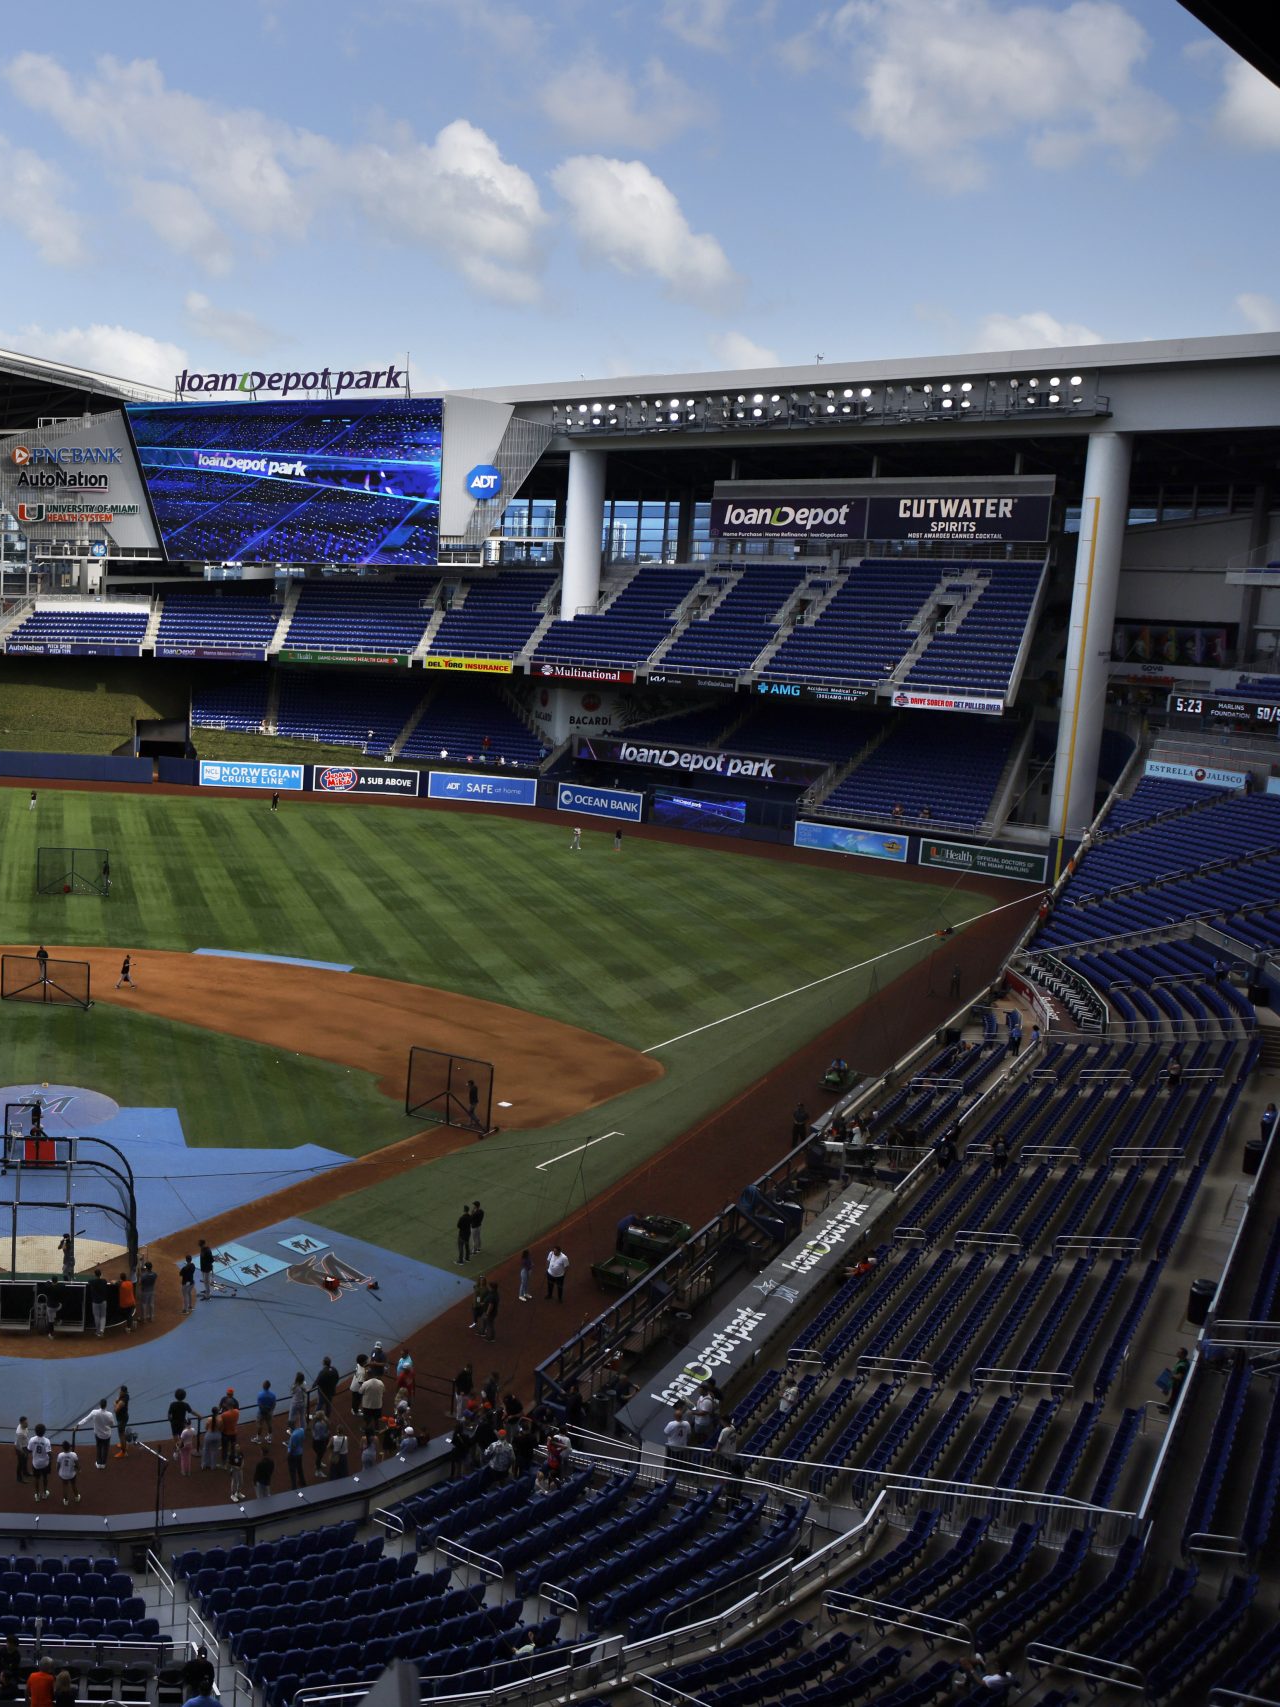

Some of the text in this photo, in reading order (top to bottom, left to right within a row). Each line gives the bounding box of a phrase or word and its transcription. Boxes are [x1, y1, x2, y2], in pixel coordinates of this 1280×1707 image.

[181, 365, 402, 397] loanDepot park
[198, 452, 308, 477] loanDepot park
[18, 471, 108, 487] AutoNation
[471, 475, 498, 488] ADT
[47, 504, 139, 514] UNIVERSITY OF MIAMI
[898, 498, 1013, 518] CUTWATER
[48, 514, 112, 522] HEALTH SYSTEM
[724, 504, 850, 530] loanDepot
[930, 522, 976, 532] SPIRITS
[93, 544, 105, 554] 42
[8, 644, 44, 652] AutoNation
[163, 648, 196, 656] loanDepot
[442, 660, 463, 668] TORO
[465, 664, 509, 672] INSURANCE
[554, 666, 620, 680] Multinational
[770, 684, 800, 696] AMG
[910, 698, 926, 706] DRIVE
[927, 699, 944, 707] SOBER
[945, 700, 954, 708] OR
[965, 702, 986, 710] PULLED
[1176, 698, 1202, 714] 5:23
[1210, 710, 1250, 719] FOUNDATION
[620, 743, 776, 778] loanDepot park
[222, 766, 300, 778] NORWEGIAN
[325, 771, 352, 780] Jersey
[1150, 764, 1242, 784] ESTRELLA JALISCO
[222, 776, 258, 784] CRUISE
[367, 777, 384, 785] SUB
[384, 778, 412, 787] ABOVE
[446, 782, 460, 790] ADT
[466, 783, 493, 794] SAFE
[574, 794, 638, 813] OCEAN BANK
[1001, 858, 1026, 867] DOCTORS
[723, 1306, 767, 1343] park
